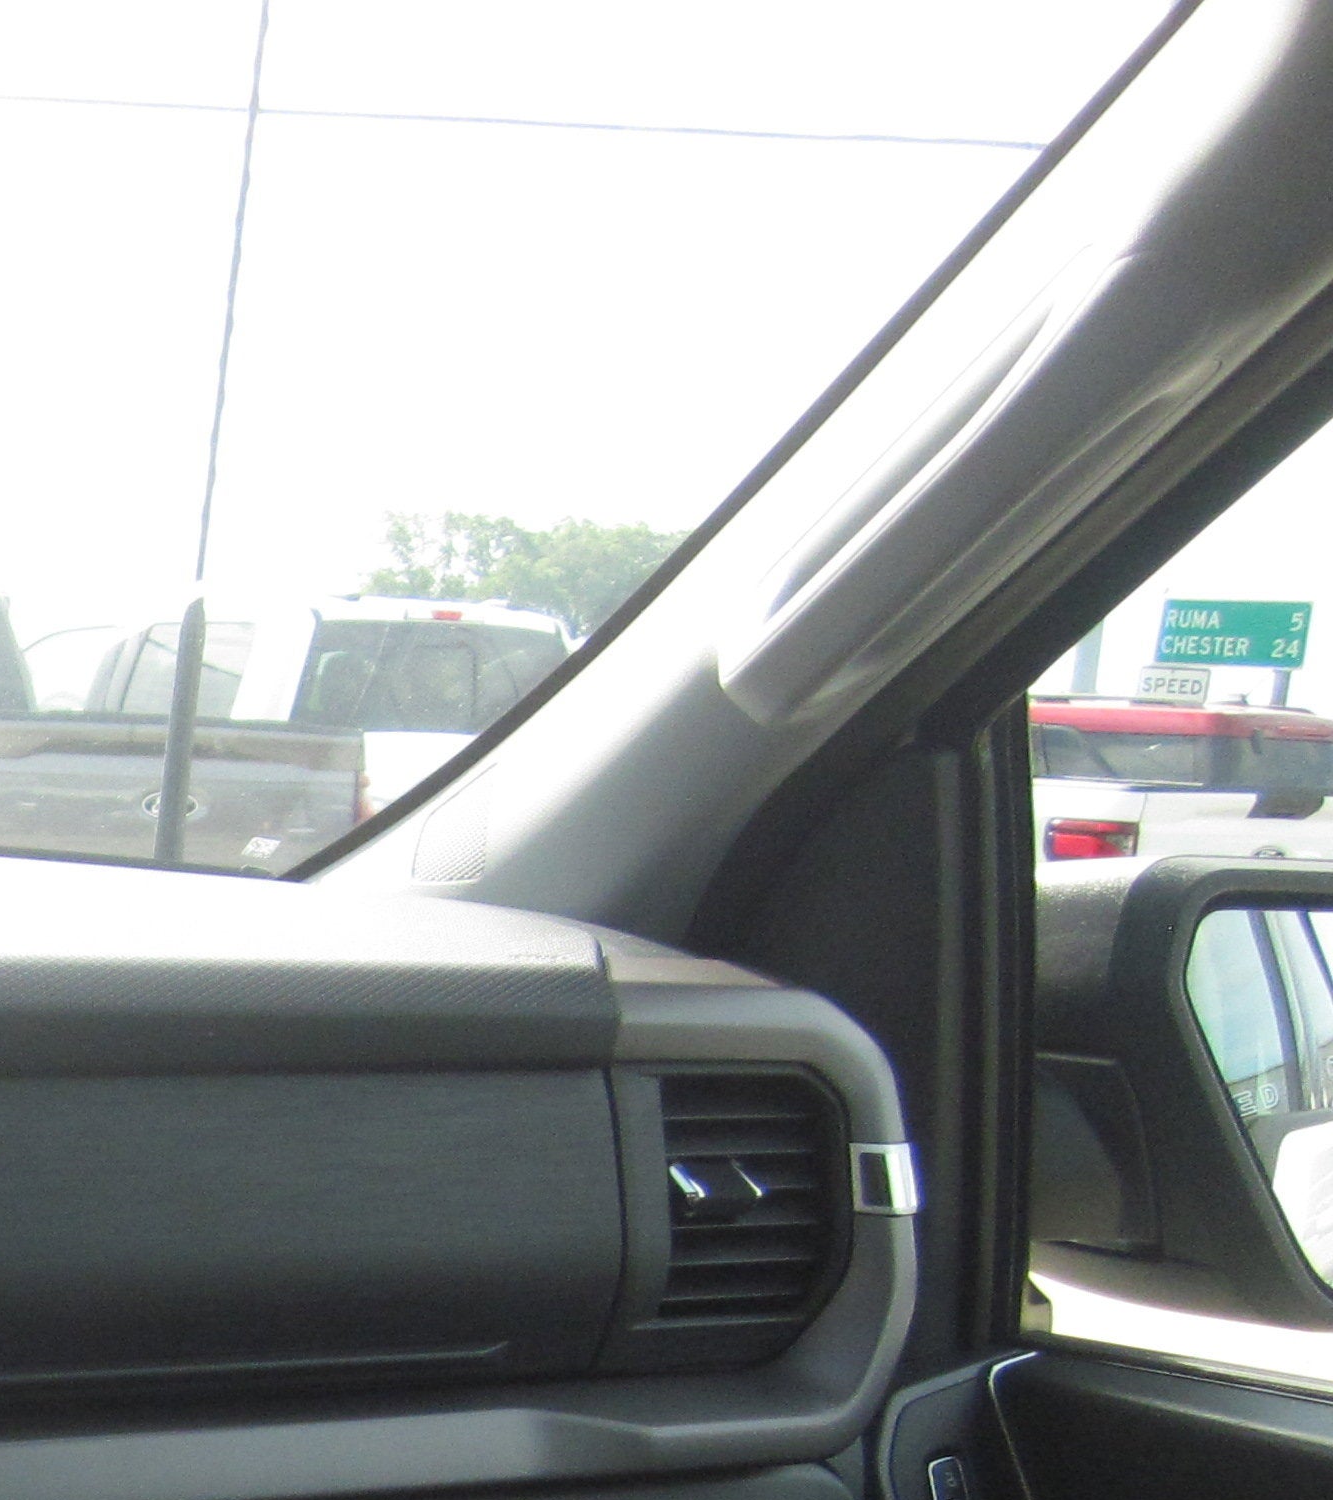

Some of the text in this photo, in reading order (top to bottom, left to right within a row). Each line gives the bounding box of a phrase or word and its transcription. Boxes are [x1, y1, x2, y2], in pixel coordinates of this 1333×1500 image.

[1165, 609, 1303, 632] RUMA 5
[1160, 635, 1300, 659] CHESTER 24
[1141, 676, 1203, 695] SPEED
